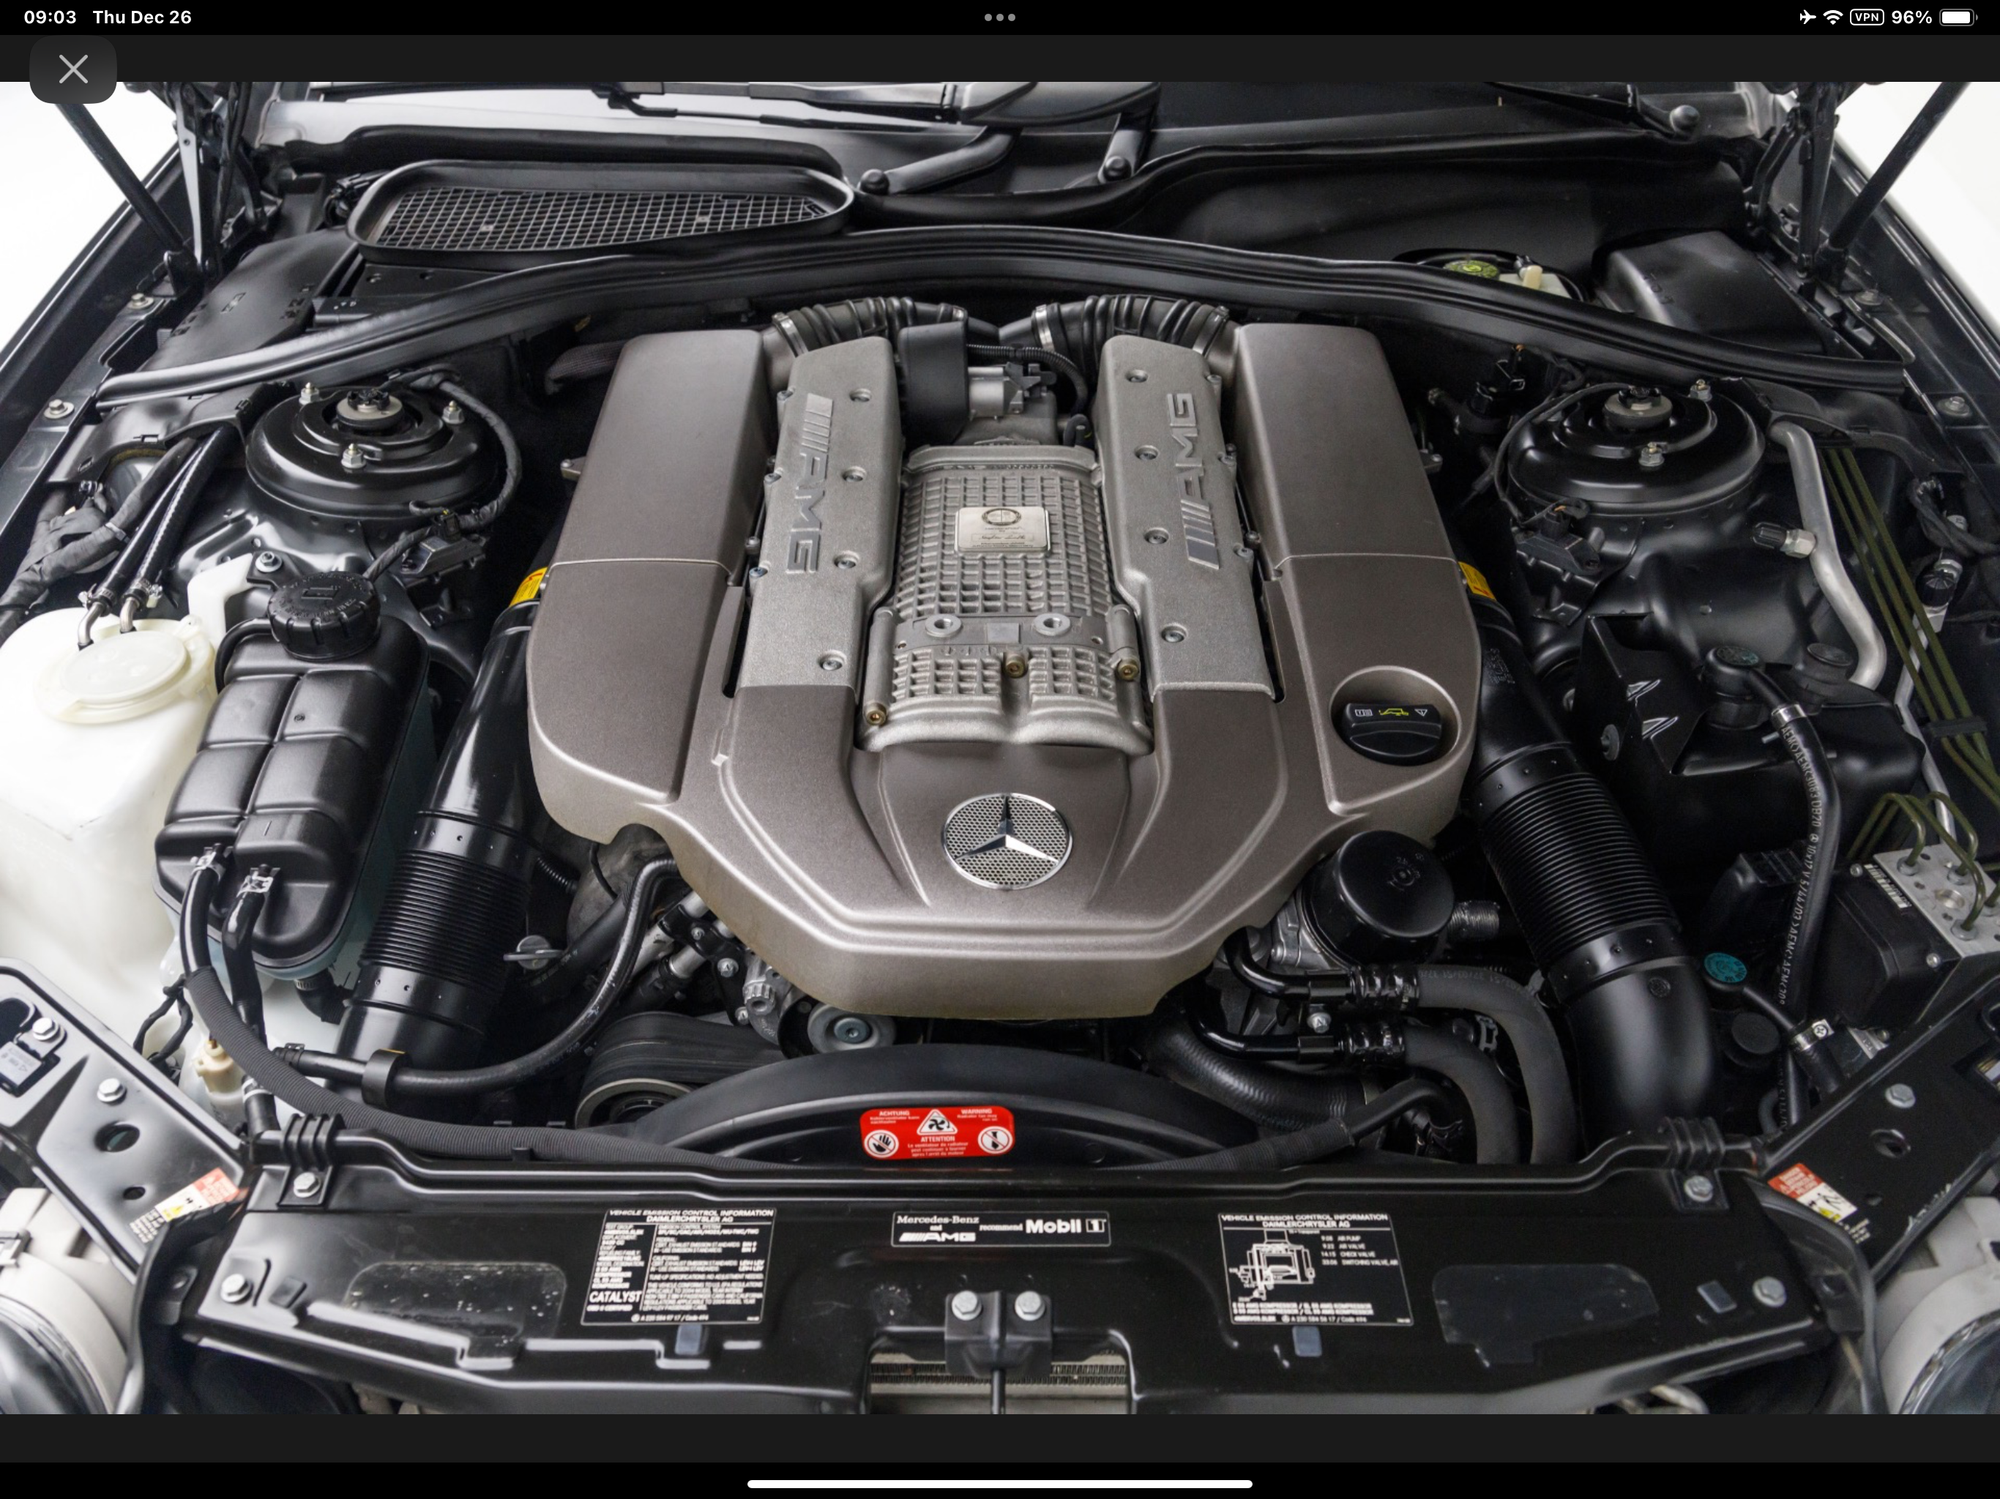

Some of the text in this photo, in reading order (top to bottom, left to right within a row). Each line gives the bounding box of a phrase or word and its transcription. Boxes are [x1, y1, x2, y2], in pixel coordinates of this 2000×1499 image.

[897, 1215, 980, 1224] Mercedes-Benz
[1025, 1218, 1082, 1234] Mobil
[589, 1291, 642, 1303] CATALYST
